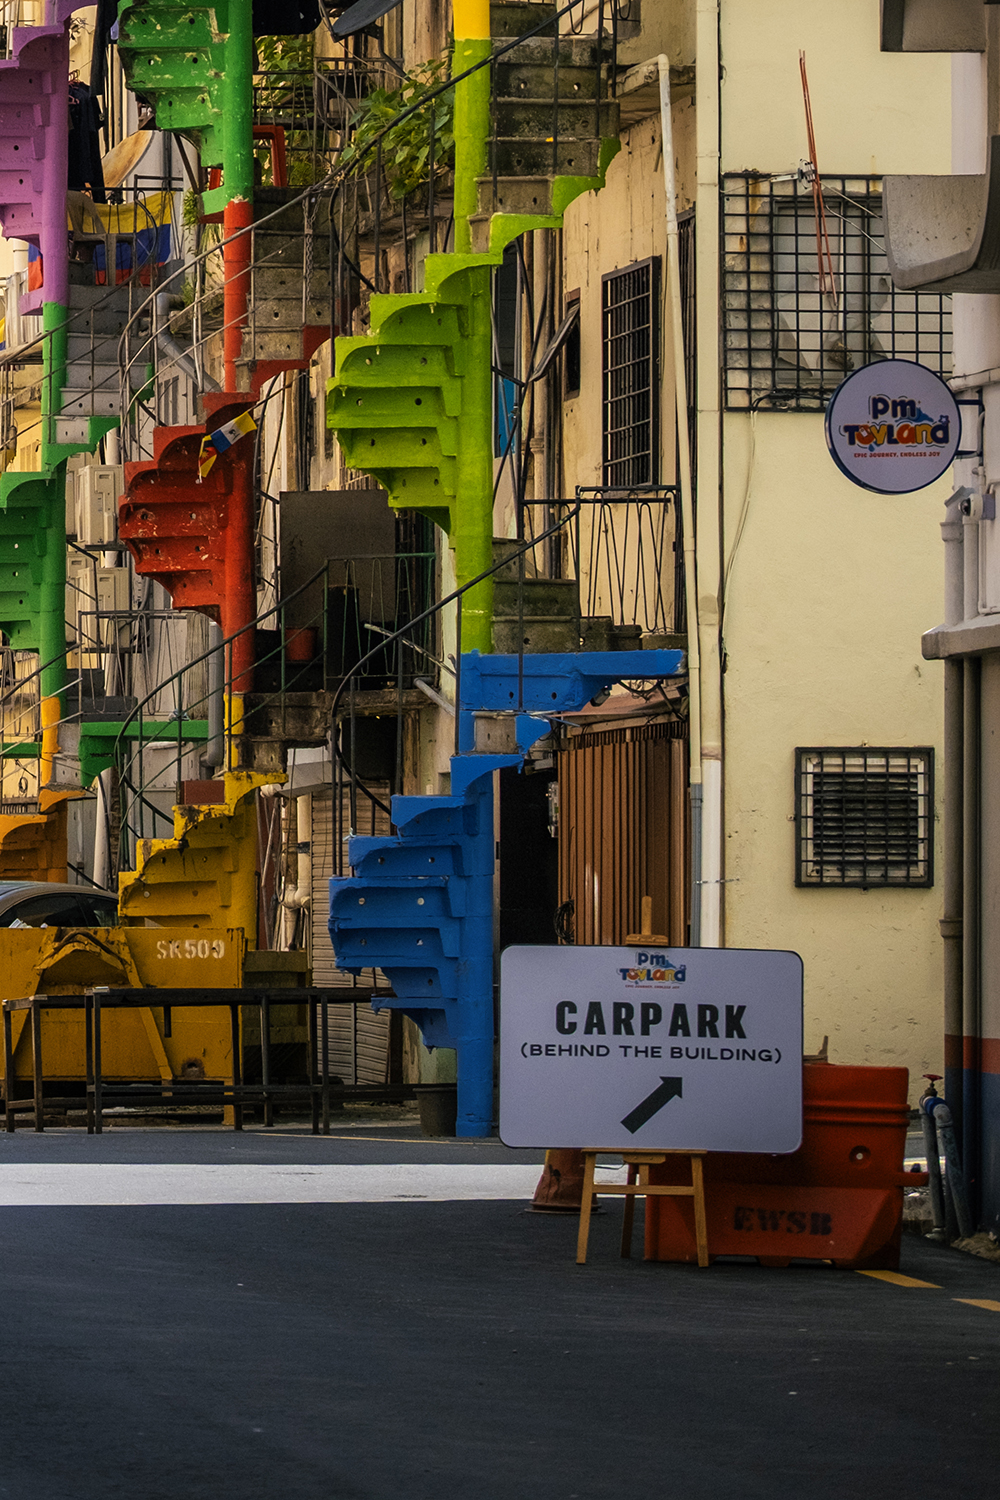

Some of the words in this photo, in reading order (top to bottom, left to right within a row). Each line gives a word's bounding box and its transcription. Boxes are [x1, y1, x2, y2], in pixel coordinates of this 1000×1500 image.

[555, 1000, 748, 1039] CARPARK
[520, 1042, 611, 1059] (BEHIND
[619, 1045, 663, 1059] THE
[669, 1046, 782, 1065] BUILDING)
